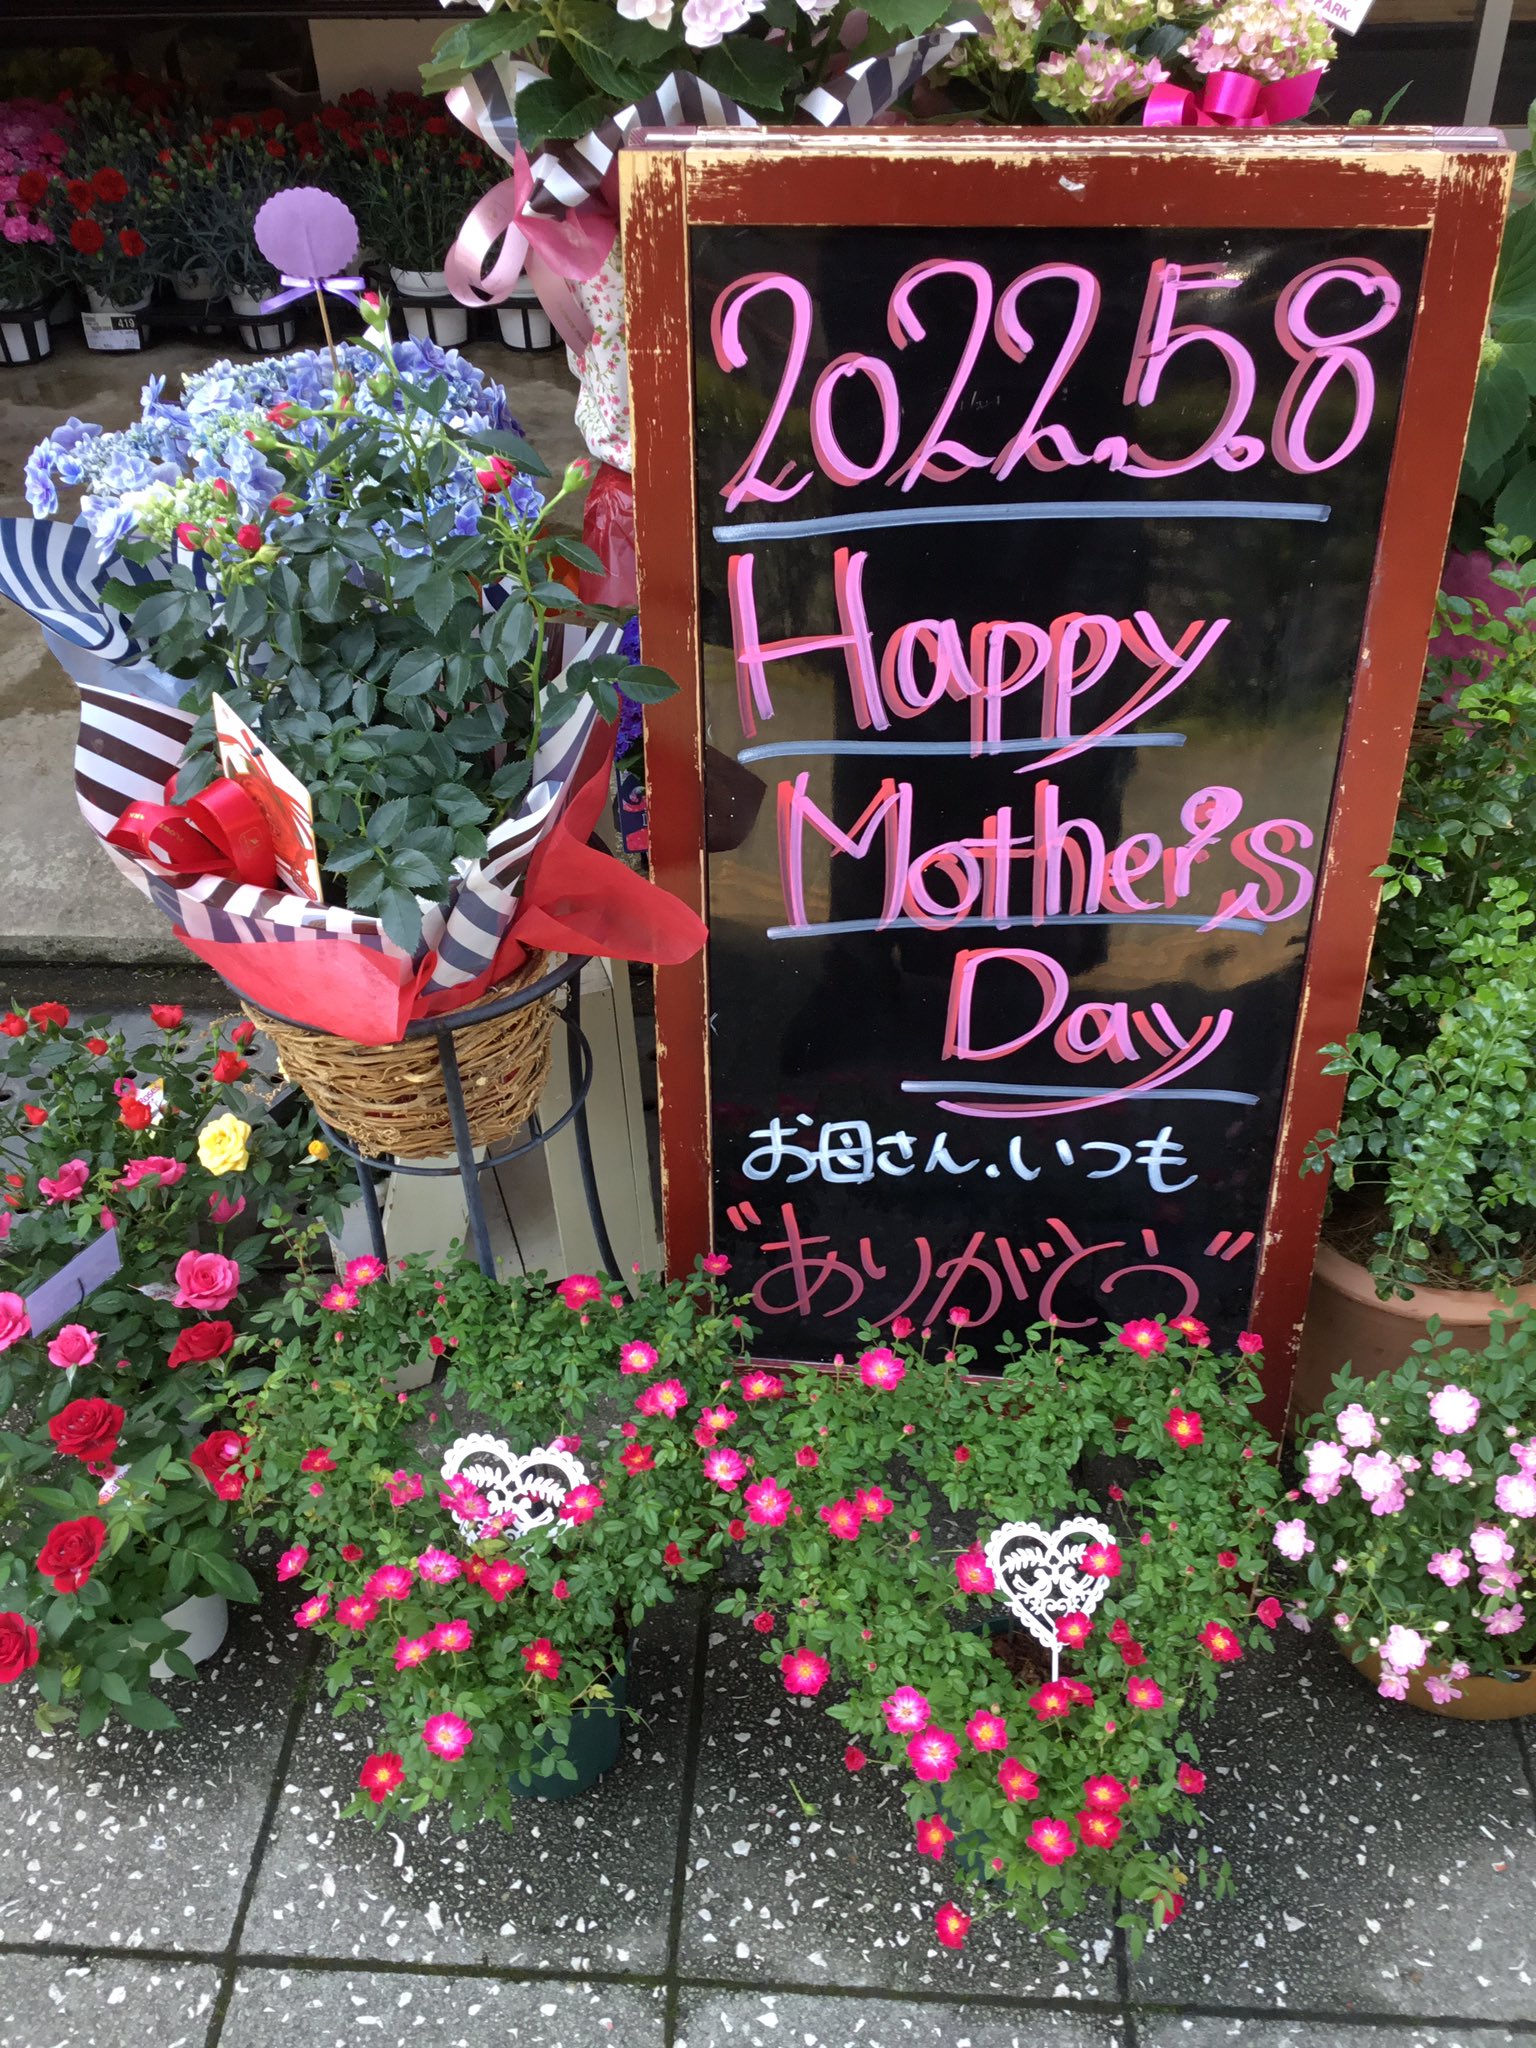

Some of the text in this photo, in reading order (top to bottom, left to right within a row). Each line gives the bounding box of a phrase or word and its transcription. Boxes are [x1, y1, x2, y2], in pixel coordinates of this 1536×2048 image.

[117, 318, 136, 328] 419
[727, 548, 1231, 773] Happy
[776, 772, 1314, 932] Mother's
[936, 948, 1233, 1118] Day
